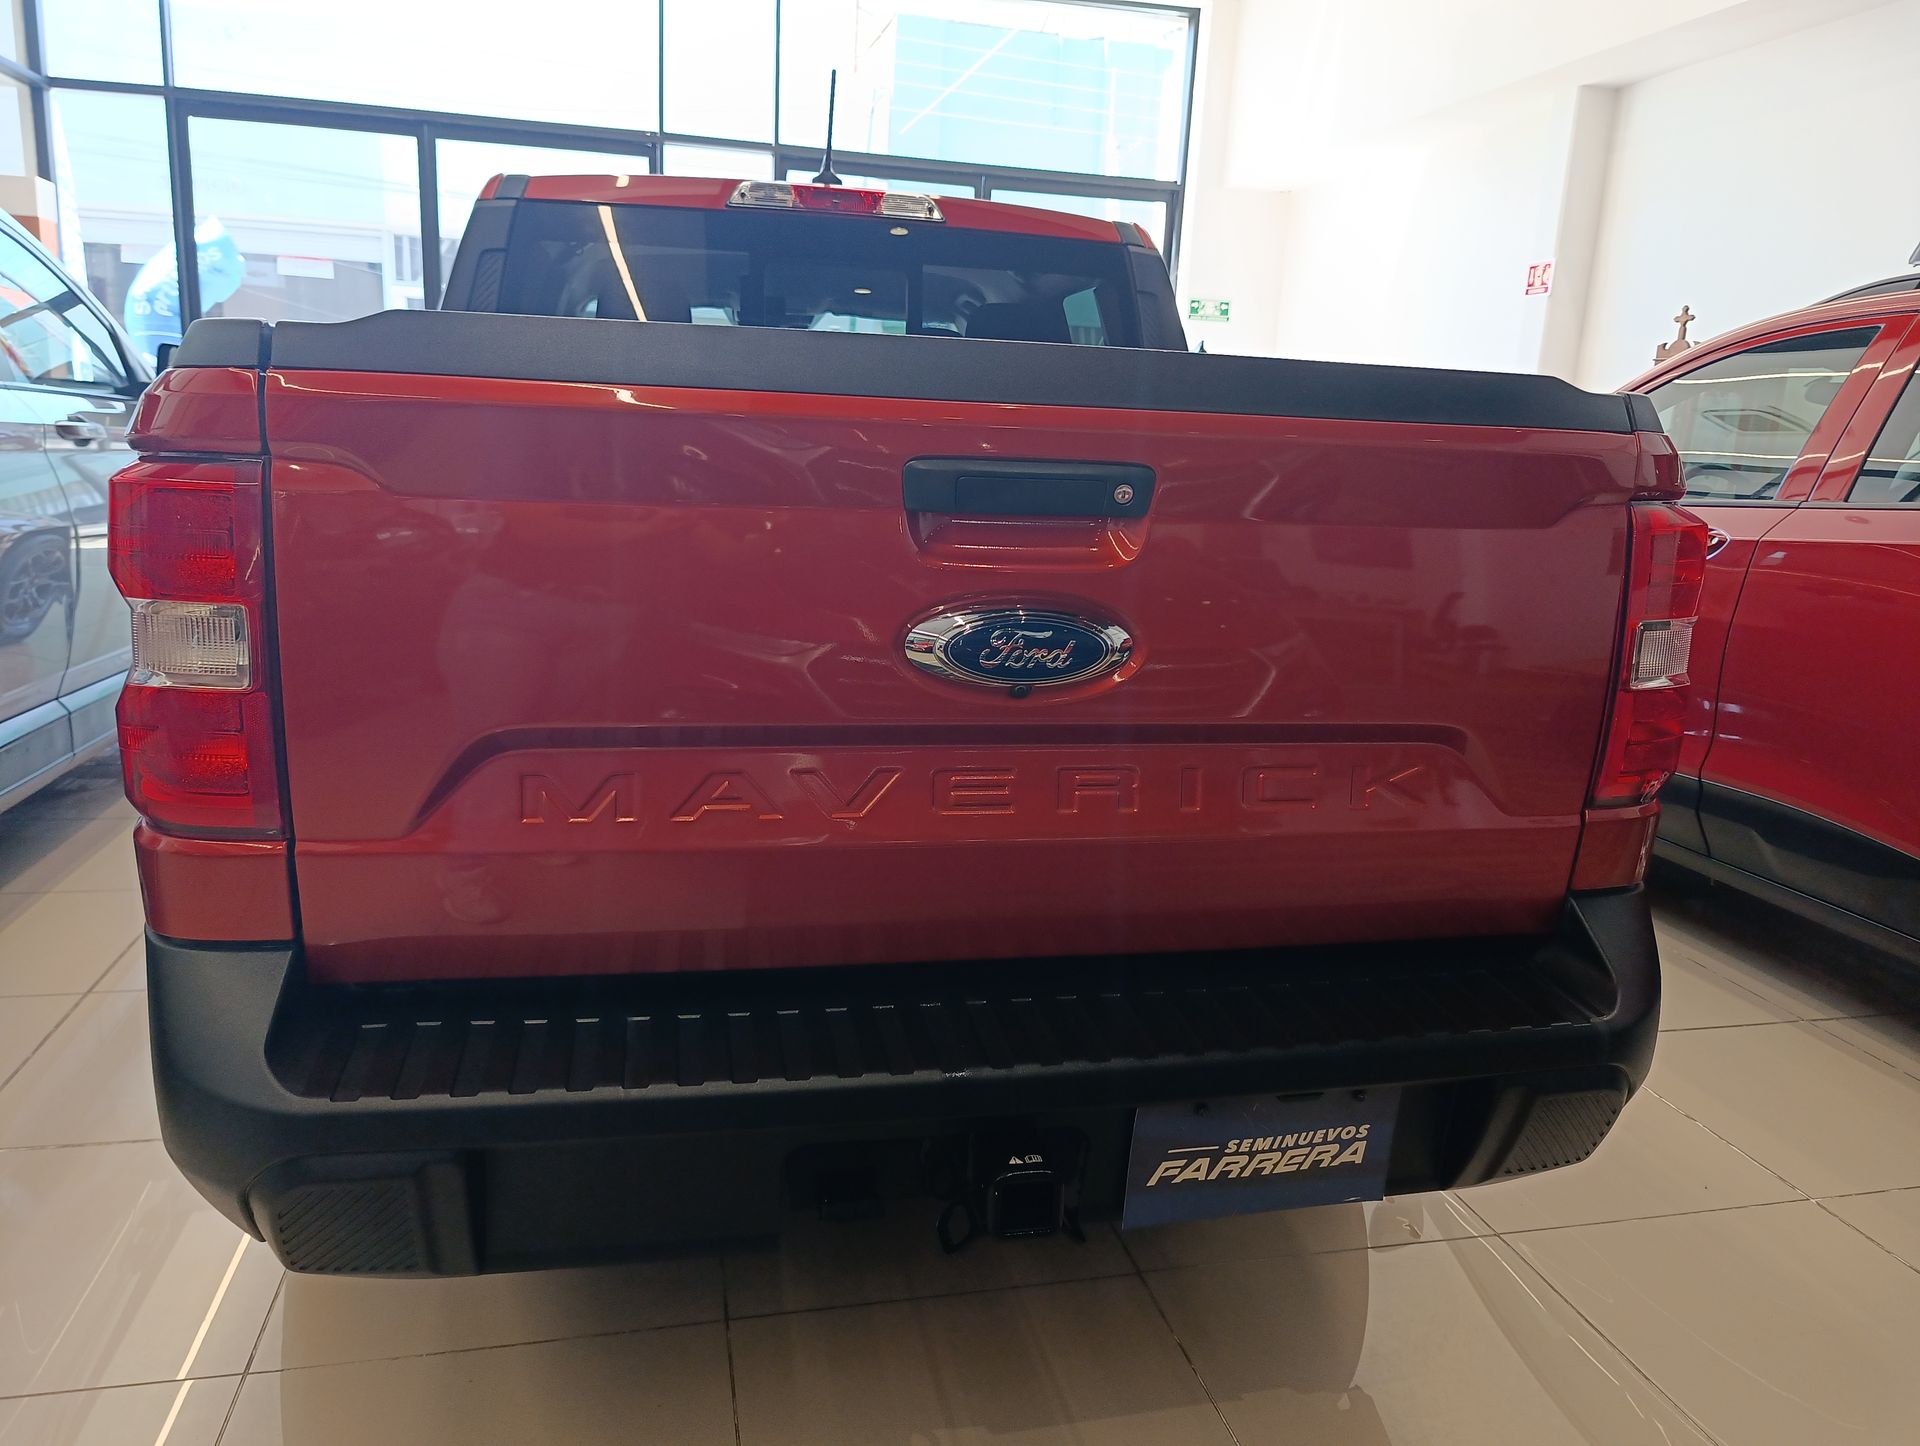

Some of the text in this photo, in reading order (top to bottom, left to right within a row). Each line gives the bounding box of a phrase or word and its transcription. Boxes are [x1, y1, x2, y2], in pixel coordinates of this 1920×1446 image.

[979, 628, 1076, 669] Ford
[520, 764, 1424, 824] MAVERICK
[1224, 1124, 1370, 1153] SEMINUEVOS
[1146, 1140, 1367, 1187] FARRERA
